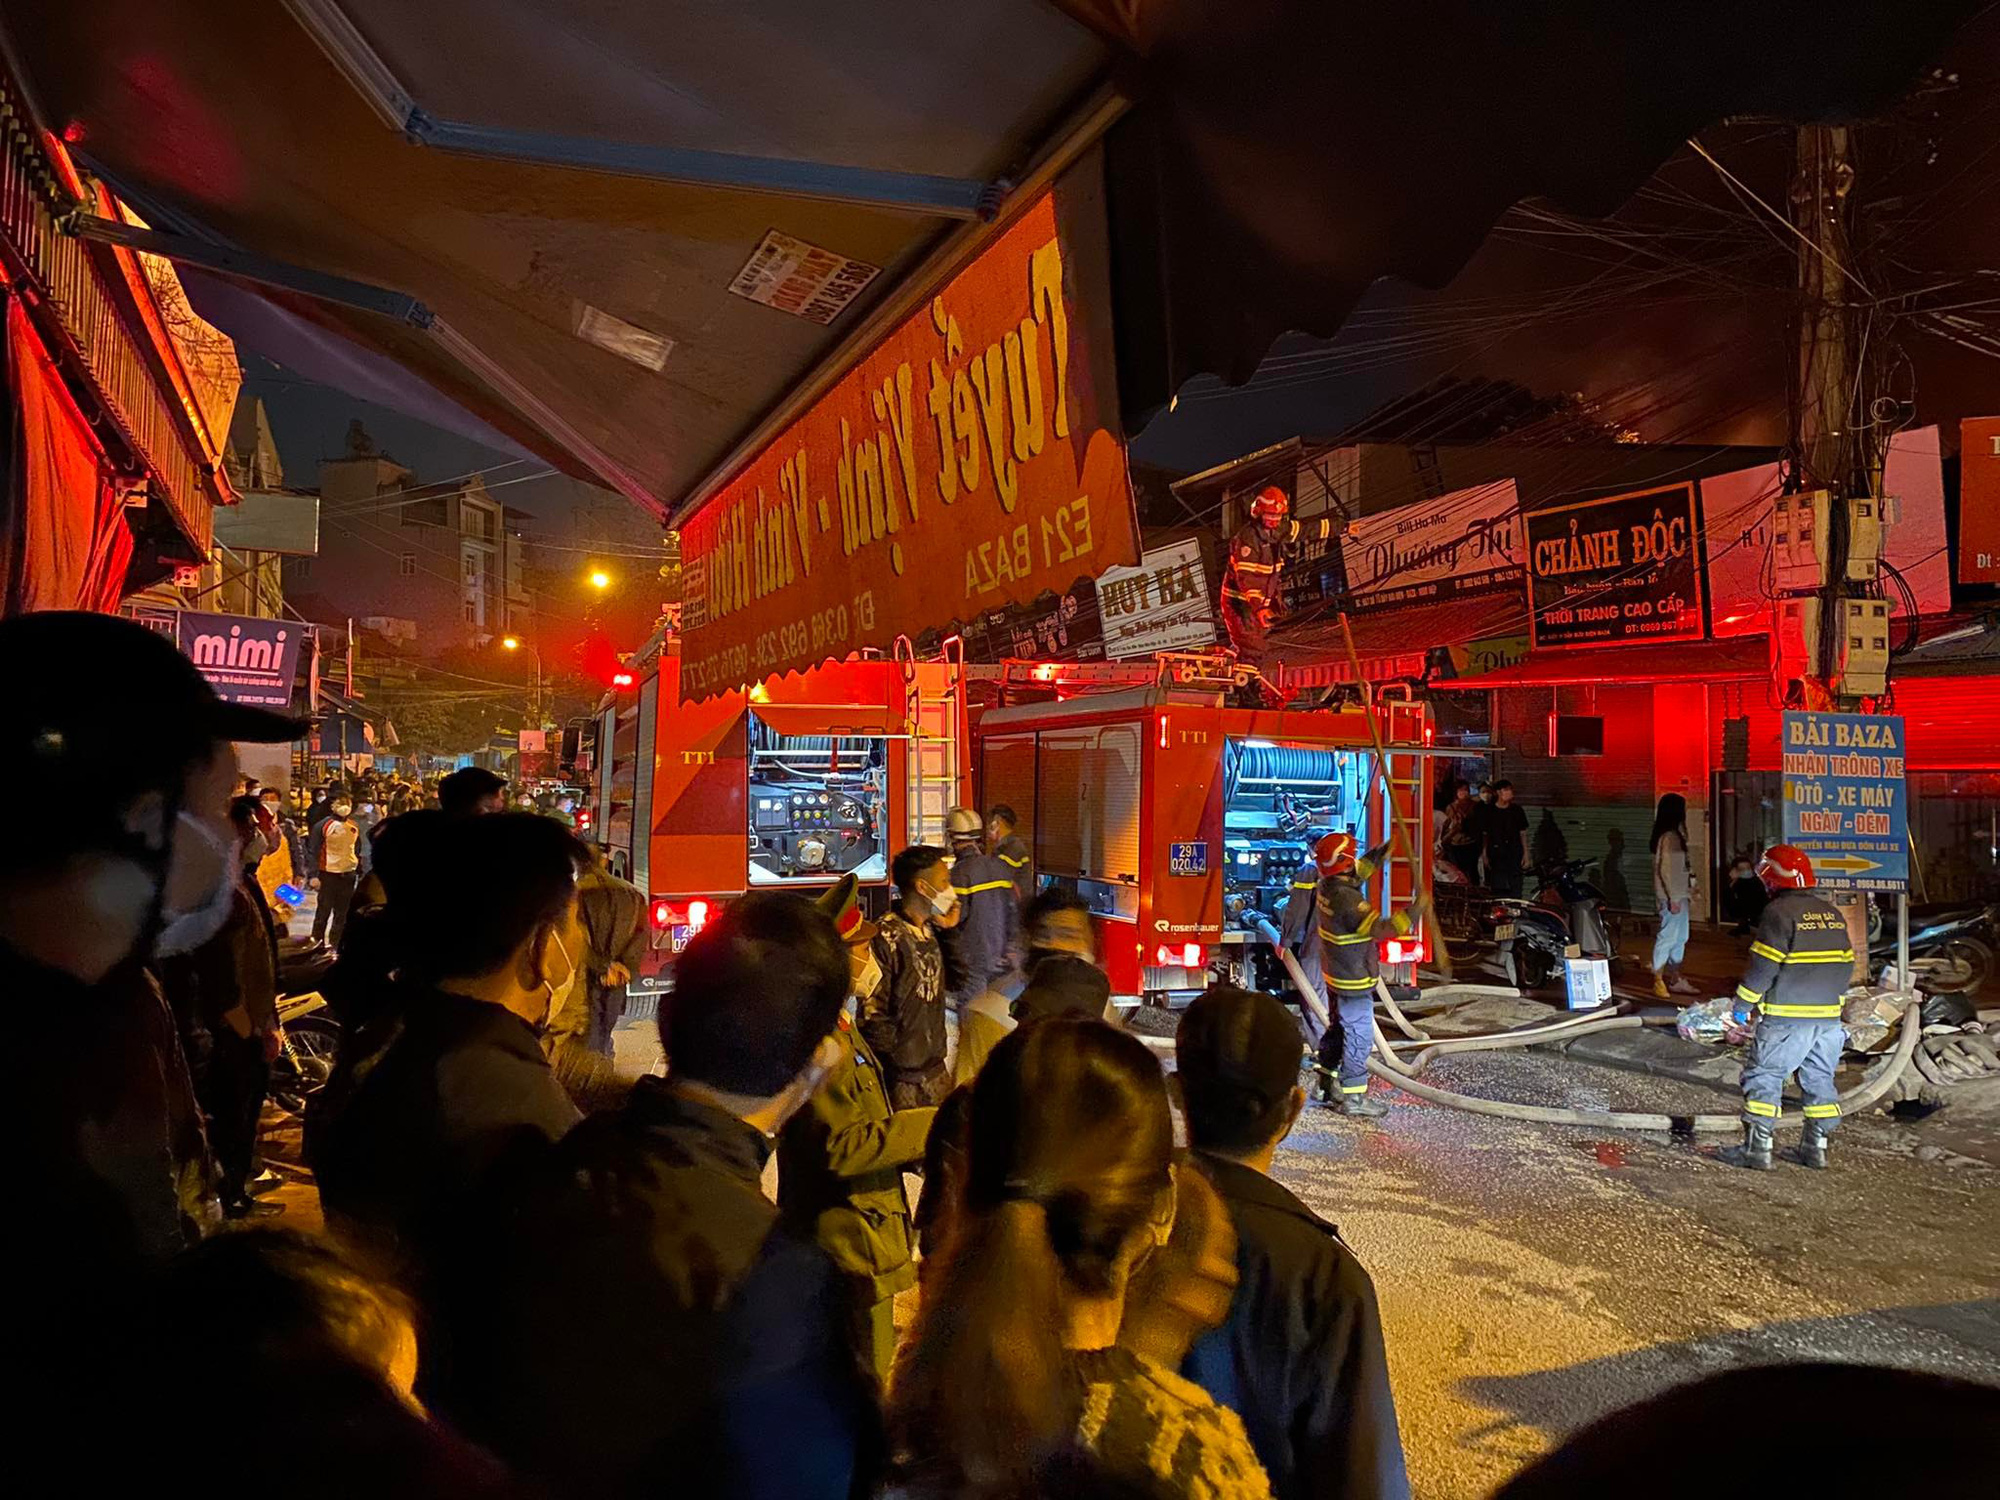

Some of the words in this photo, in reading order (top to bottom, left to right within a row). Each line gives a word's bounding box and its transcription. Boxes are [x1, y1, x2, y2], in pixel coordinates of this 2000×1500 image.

[1535, 517, 1621, 577] CHẢNH
[1630, 507, 1687, 568] ĐỘC
[1576, 604, 1620, 622] TRANG
[1624, 601, 1652, 618] CAO
[1657, 592, 1685, 614] CẤP
[193, 625, 287, 671] mimi
[1179, 730, 1208, 744] TT1
[1789, 715, 1830, 746] BÃI
[1835, 724, 1897, 749] BAZA
[680, 751, 715, 765] TT1
[1783, 750, 1828, 780] NHẬN
[1830, 751, 1881, 778] TRÔNG
[1882, 757, 1904, 779] XE
[1794, 781, 1823, 805] ÔTÔ
[1837, 786, 1857, 806] XE
[1861, 784, 1894, 807] MÁY
[1800, 807, 1843, 834] NGÀY
[1854, 809, 1890, 835] ĐÊM
[1179, 845, 1198, 858] 29A
[1170, 922, 1219, 932] rosenbauer
